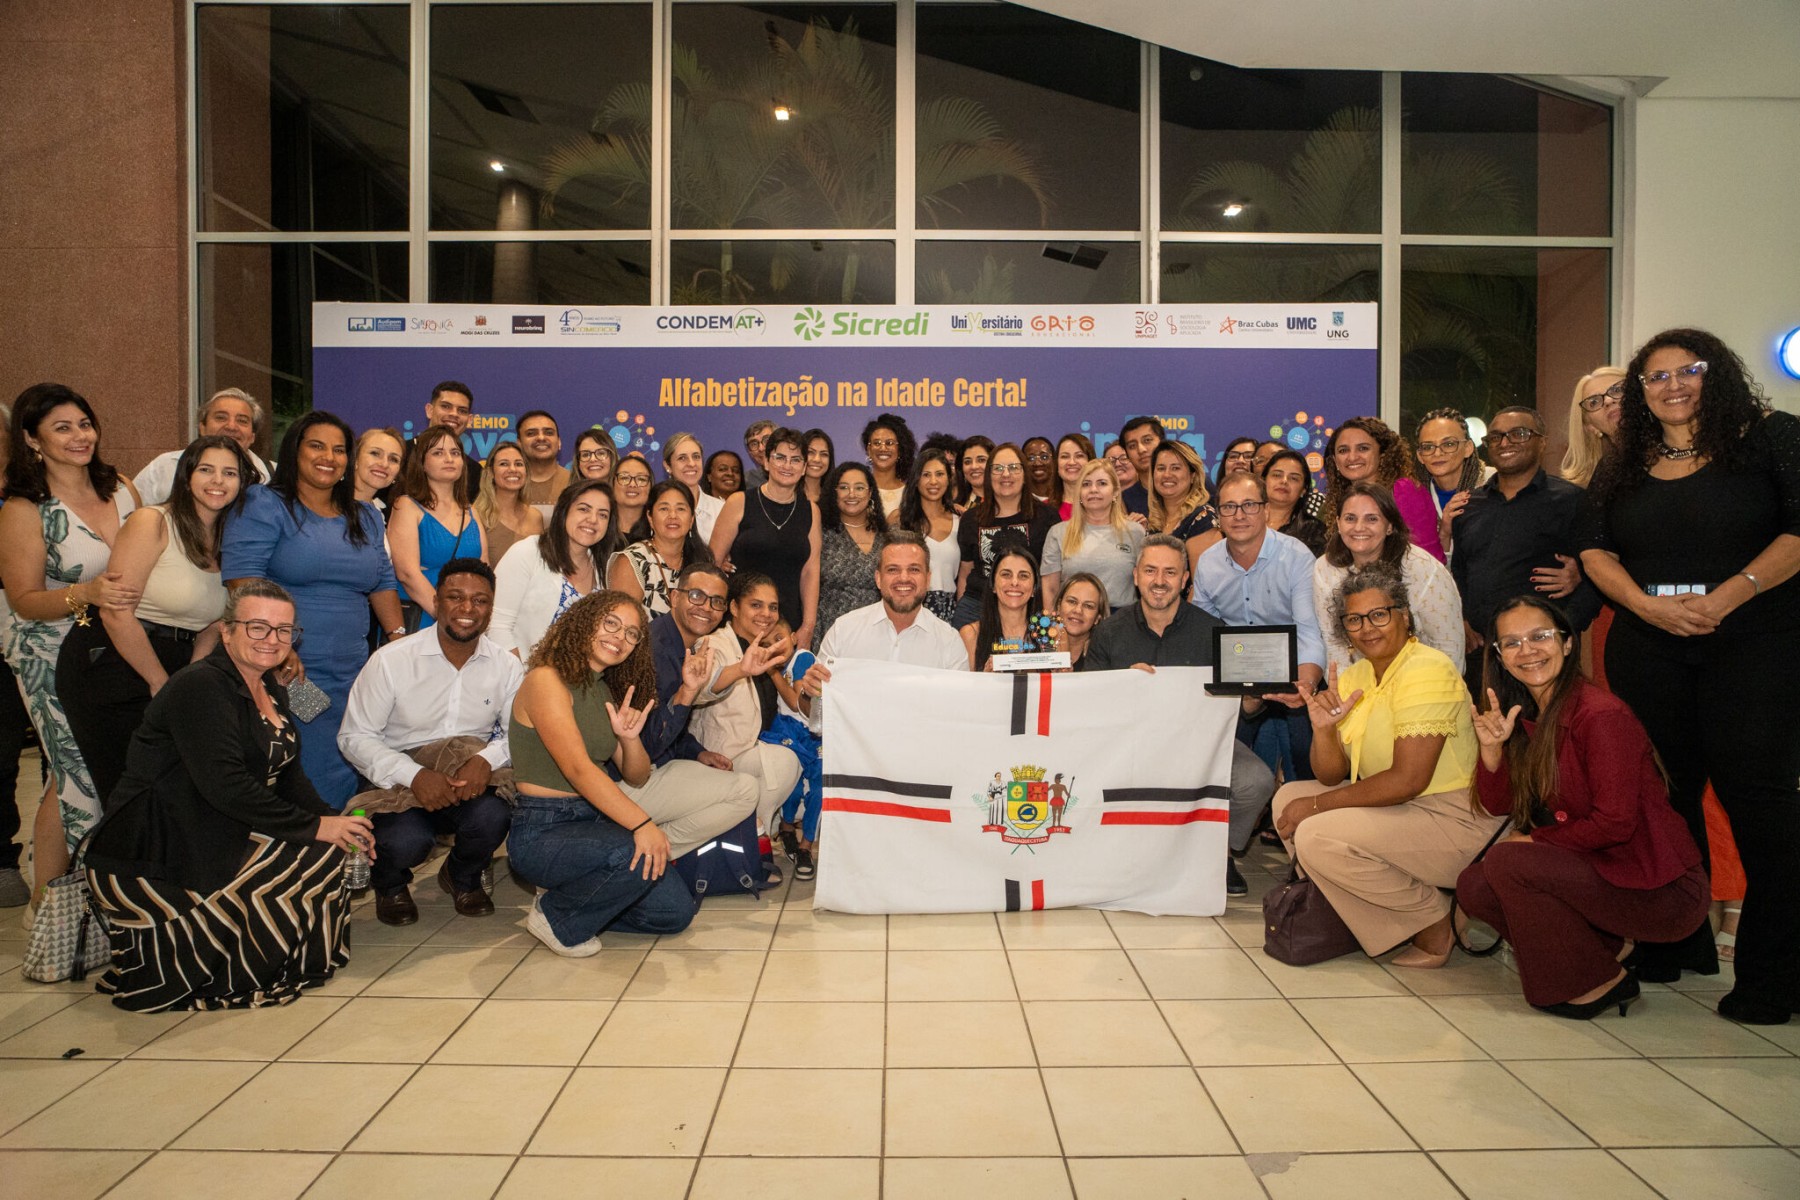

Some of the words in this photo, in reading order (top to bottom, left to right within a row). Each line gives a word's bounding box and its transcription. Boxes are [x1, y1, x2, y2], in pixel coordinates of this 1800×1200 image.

[831, 312, 929, 335] Sicredi
[1286, 317, 1317, 330] UMC
[1327, 330, 1349, 338] UNG
[659, 376, 829, 416] Alfabetização
[836, 381, 868, 407] na
[876, 378, 946, 407] Idade
[953, 378, 1027, 407] Certa!
[467, 414, 509, 429] ÊMIO
